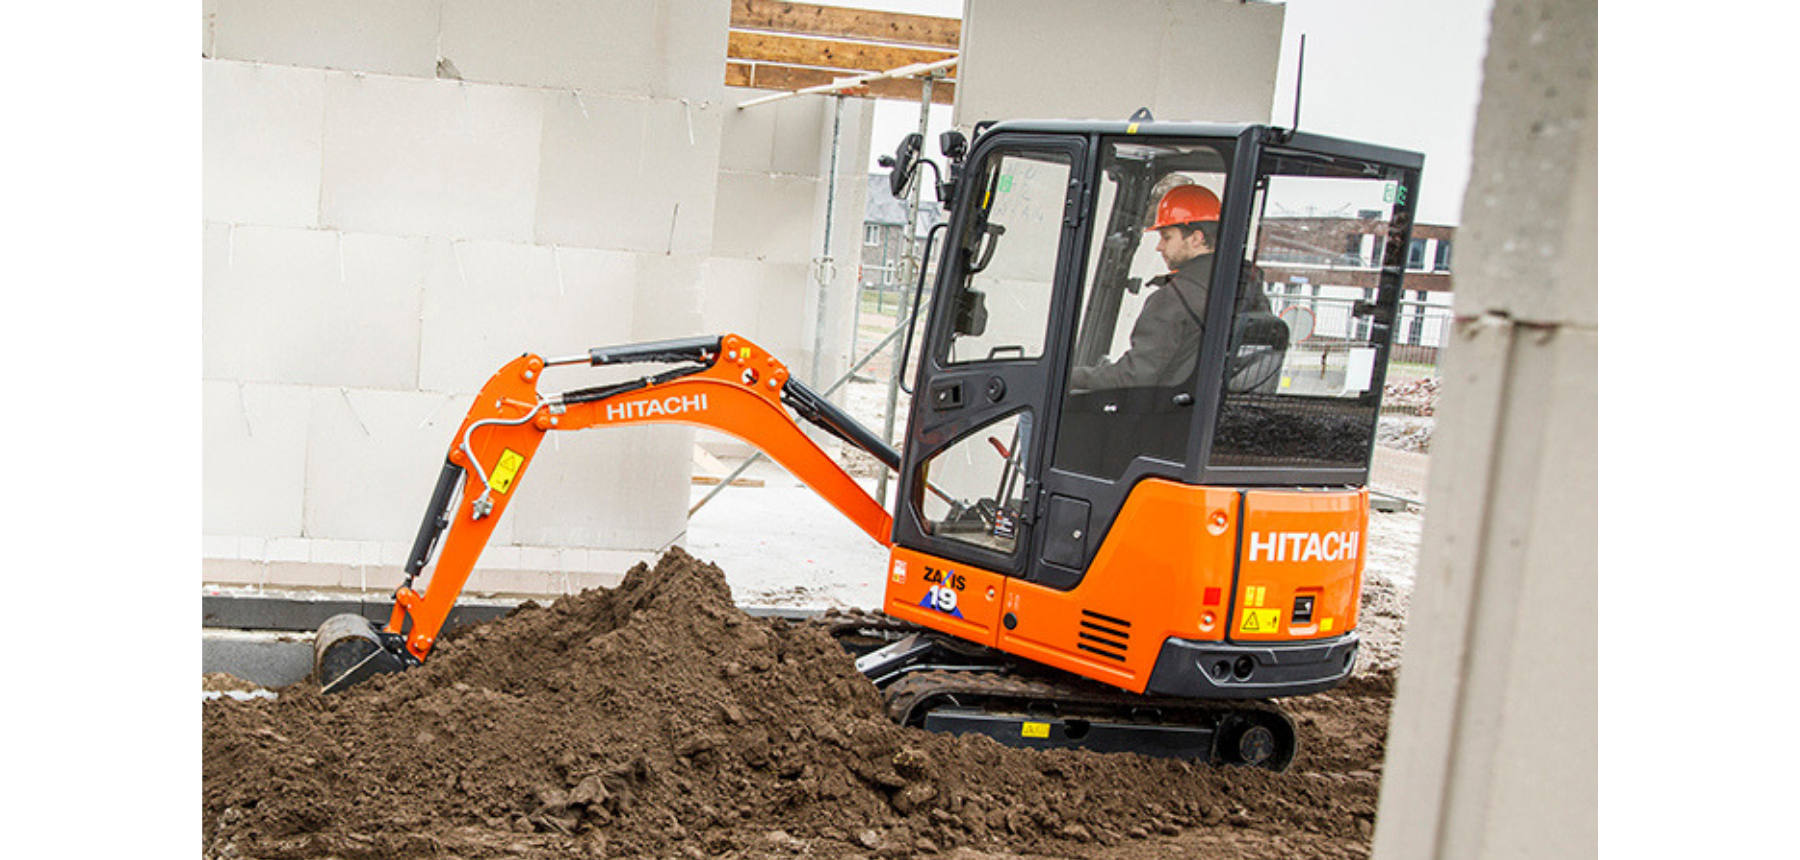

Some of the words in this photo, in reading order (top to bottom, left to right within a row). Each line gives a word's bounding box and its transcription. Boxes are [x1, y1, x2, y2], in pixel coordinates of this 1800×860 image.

[606, 393, 707, 421] HITACHI
[1249, 531, 1359, 562] HITACHI
[923, 566, 966, 591] ZAXIS
[929, 585, 957, 611] 19
